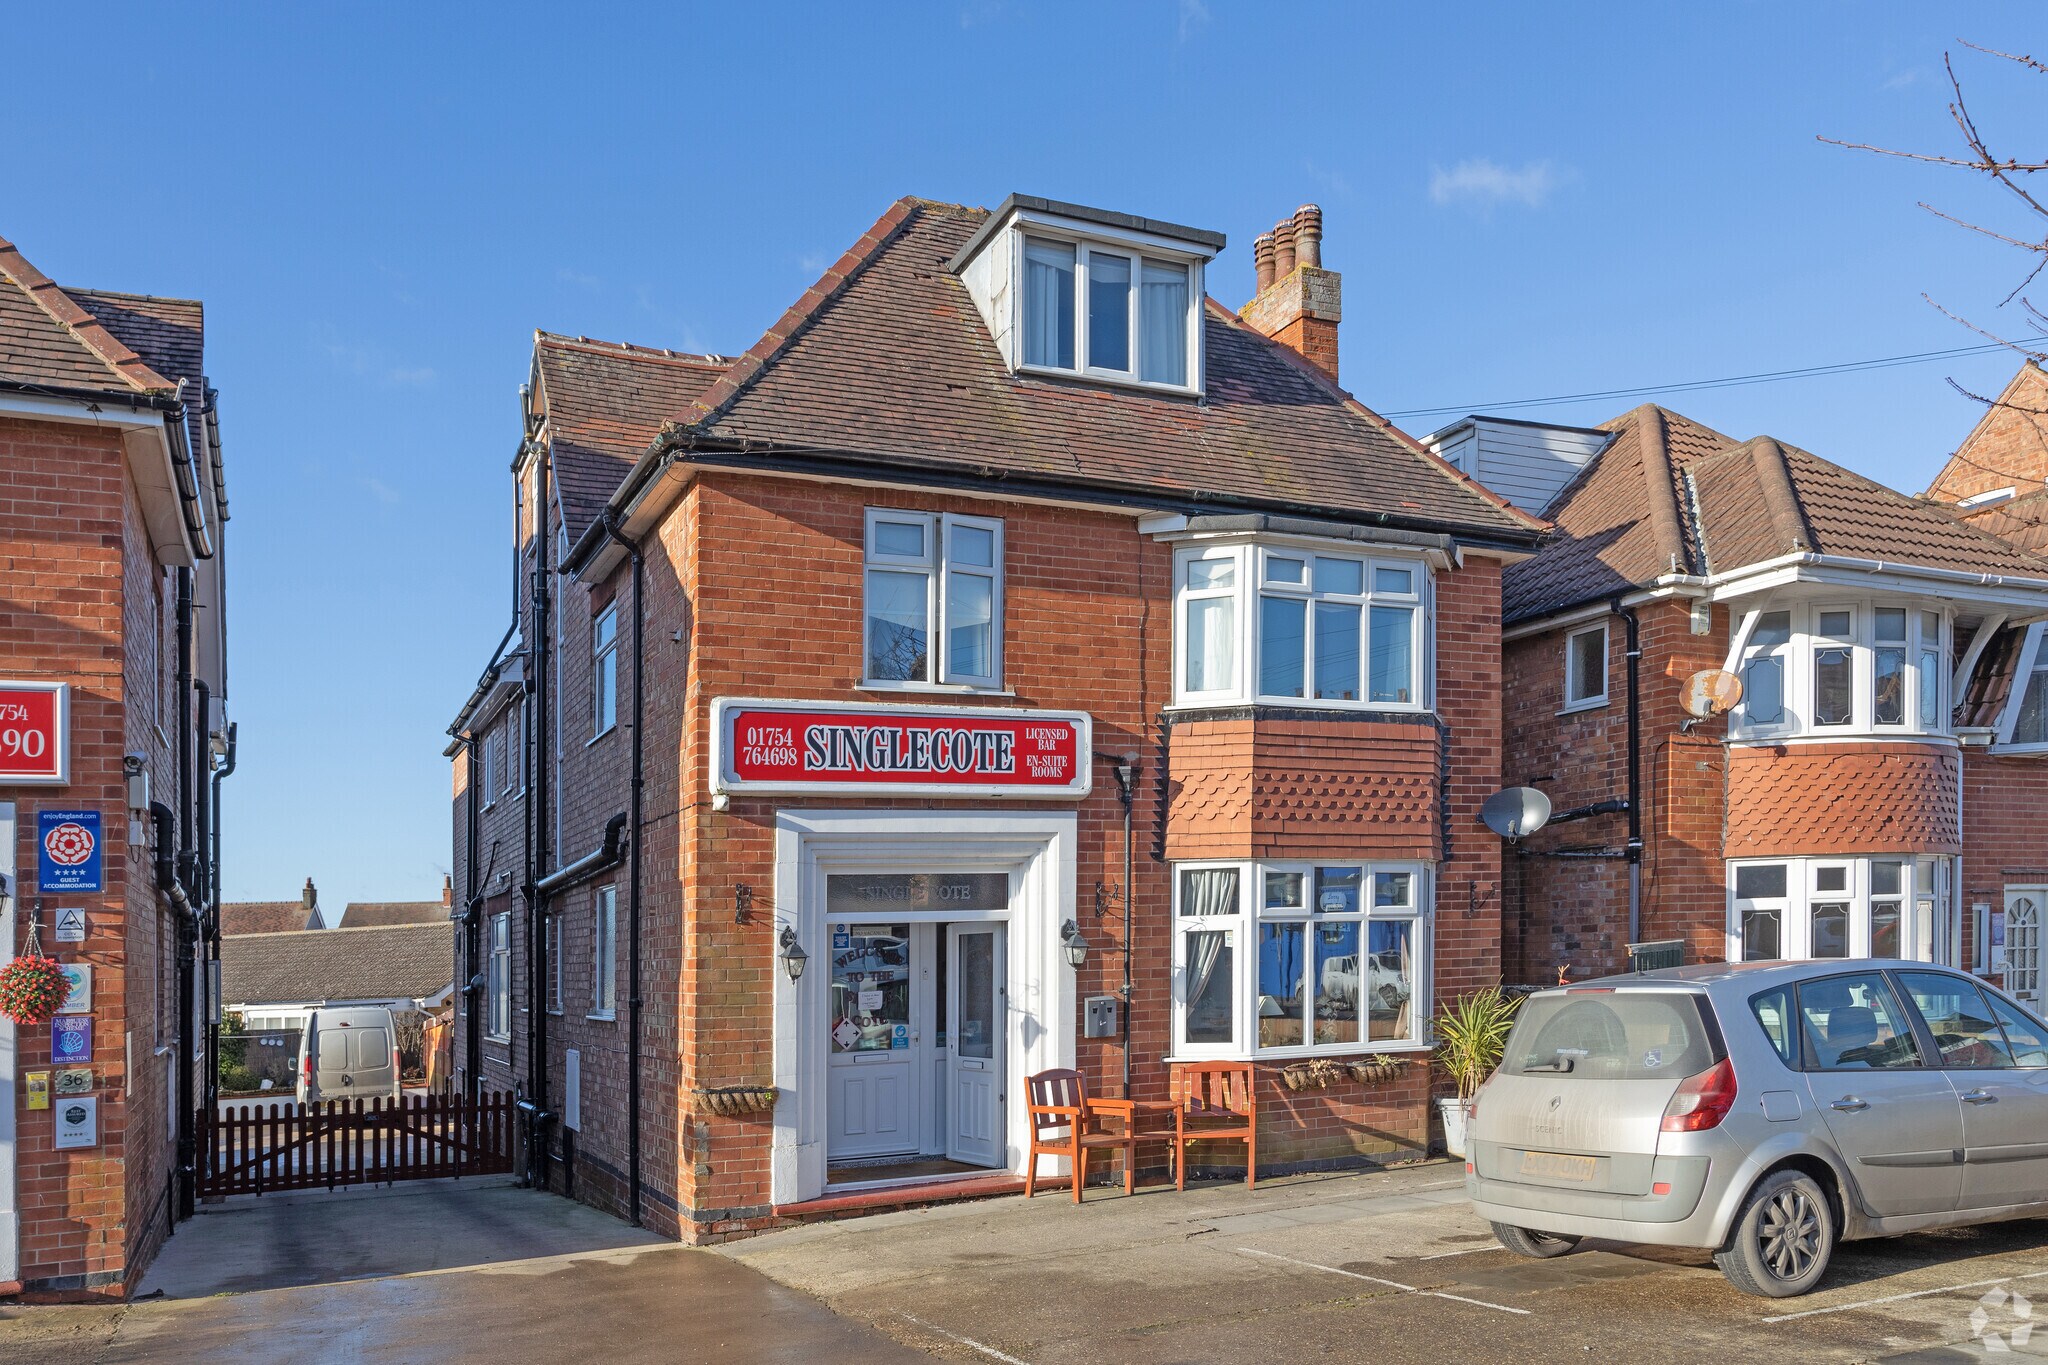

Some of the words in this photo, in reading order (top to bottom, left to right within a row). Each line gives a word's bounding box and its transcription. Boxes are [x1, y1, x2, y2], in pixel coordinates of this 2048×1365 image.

[747, 727, 793, 747] 01754
[1025, 727, 1068, 740] LICENSED
[0, 729, 45, 758] 90
[804, 724, 1015, 774] SINGLECOTE
[1037, 739, 1056, 750] BAR
[743, 747, 798, 766] 764698
[1026, 755, 1068, 768] EN-SUITE
[1031, 766, 1062, 778] ROOMS
[846, 972, 865, 983] TO
[870, 971, 895, 982] THE
[63, 1074, 83, 1086] 36
[1535, 1124, 1563, 1135] SCENIC
